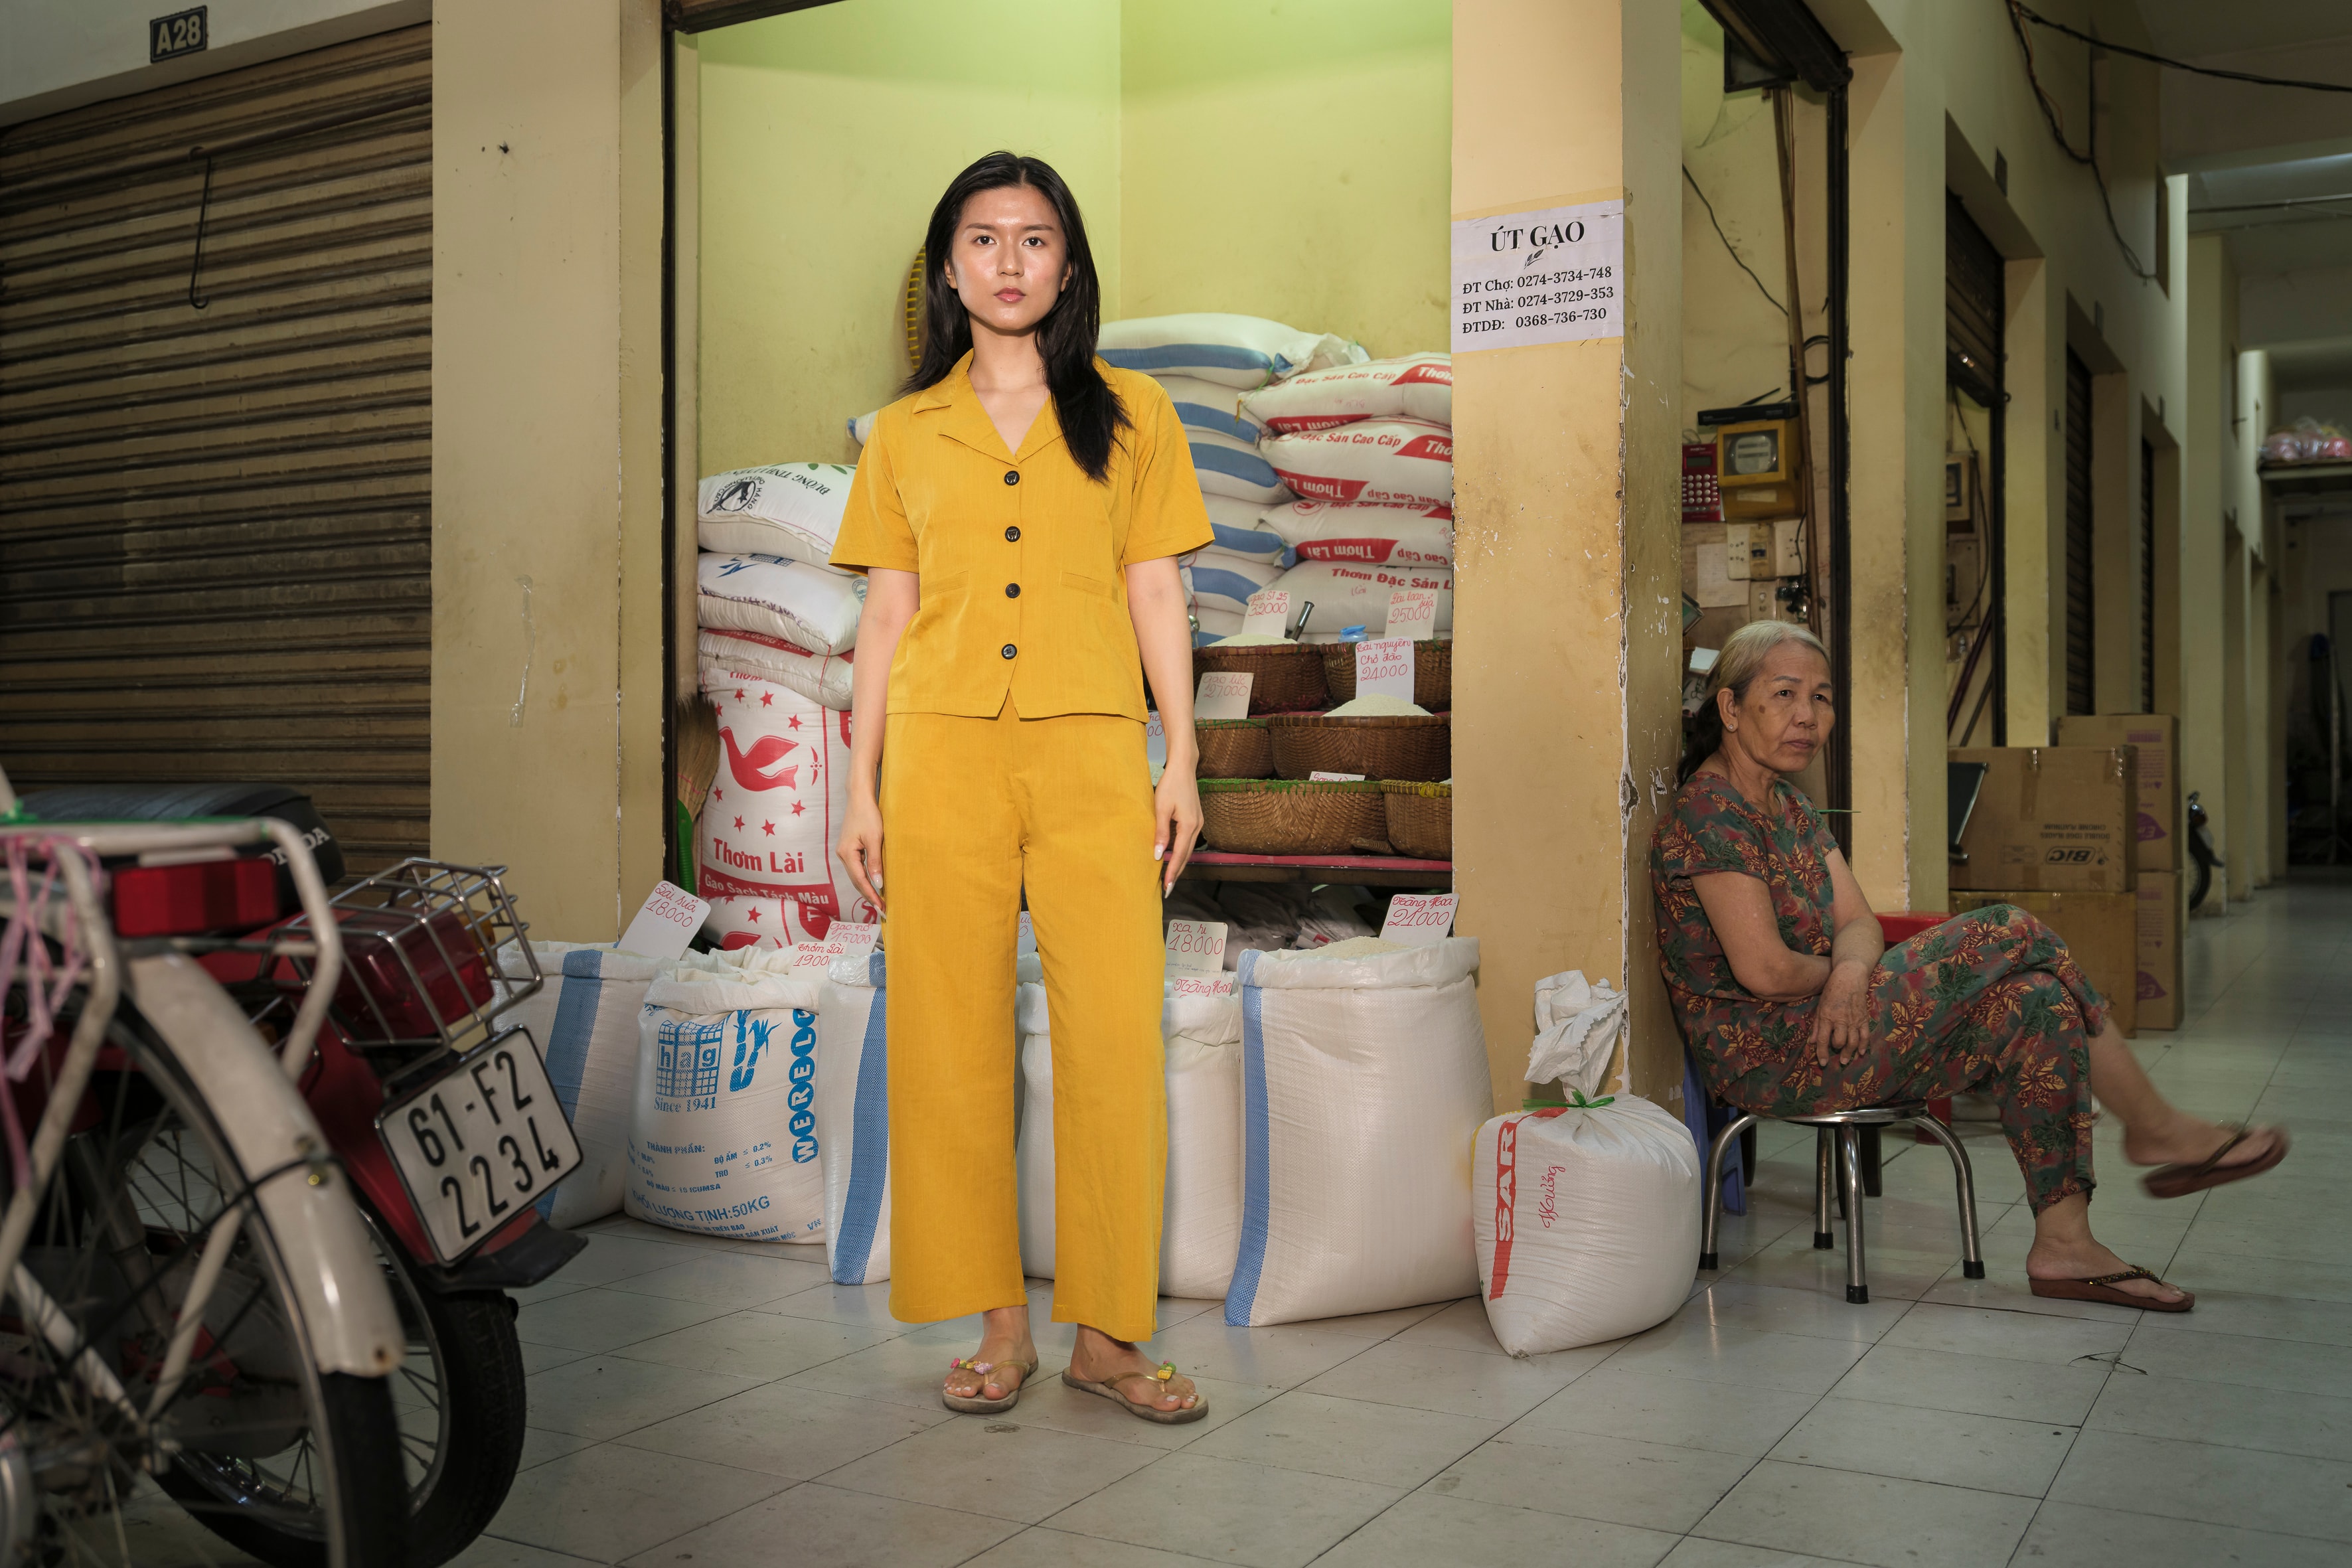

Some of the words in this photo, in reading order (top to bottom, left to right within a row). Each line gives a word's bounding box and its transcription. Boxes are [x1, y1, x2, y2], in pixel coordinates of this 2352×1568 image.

[156, 15, 201, 54] A28
[1491, 225, 1524, 252] ÚT
[1530, 221, 1585, 249] GẠO
[1462, 282, 1482, 294] ĐT
[1485, 278, 1514, 294] Chợ:
[1517, 266, 1612, 287] 0274-3734-748
[1462, 302, 1482, 314] ĐT
[1485, 298, 1514, 311] Nhà:
[1518, 286, 1614, 307] 0274-3729-353
[1462, 319, 1504, 333] ĐTDĐ:
[1516, 308, 1607, 327] 0368-736-730
[1352, 433, 1374, 445] Cao
[1377, 435, 1401, 447] Cấp
[1334, 545, 1375, 558] Thơm
[1397, 548, 1421, 562] Cấp
[1424, 554, 1448, 565] Cao
[1331, 568, 1372, 581] Thơm
[1377, 573, 1406, 588] Đặc
[1411, 577, 1439, 589] Sản
[713, 837, 762, 872] Thơm
[769, 852, 804, 873] Lài
[2048, 849, 2091, 862] BIC
[704, 874, 724, 891] Gạo
[798, 892, 829, 904] Màu
[660, 1045, 717, 1068] hag
[654, 1097, 682, 1113] Since
[686, 1095, 717, 1112] 1941
[647, 1140, 672, 1154] THÀNH
[753, 1140, 771, 1152] 0.2%
[715, 1169, 729, 1178] TRO
[754, 1154, 773, 1167] 0.3%
[441, 1117, 560, 1238] 2234
[1498, 1128, 1514, 1241] SAR
[655, 1204, 694, 1222] LƯỢNG
[731, 1223, 745, 1231] BAO
